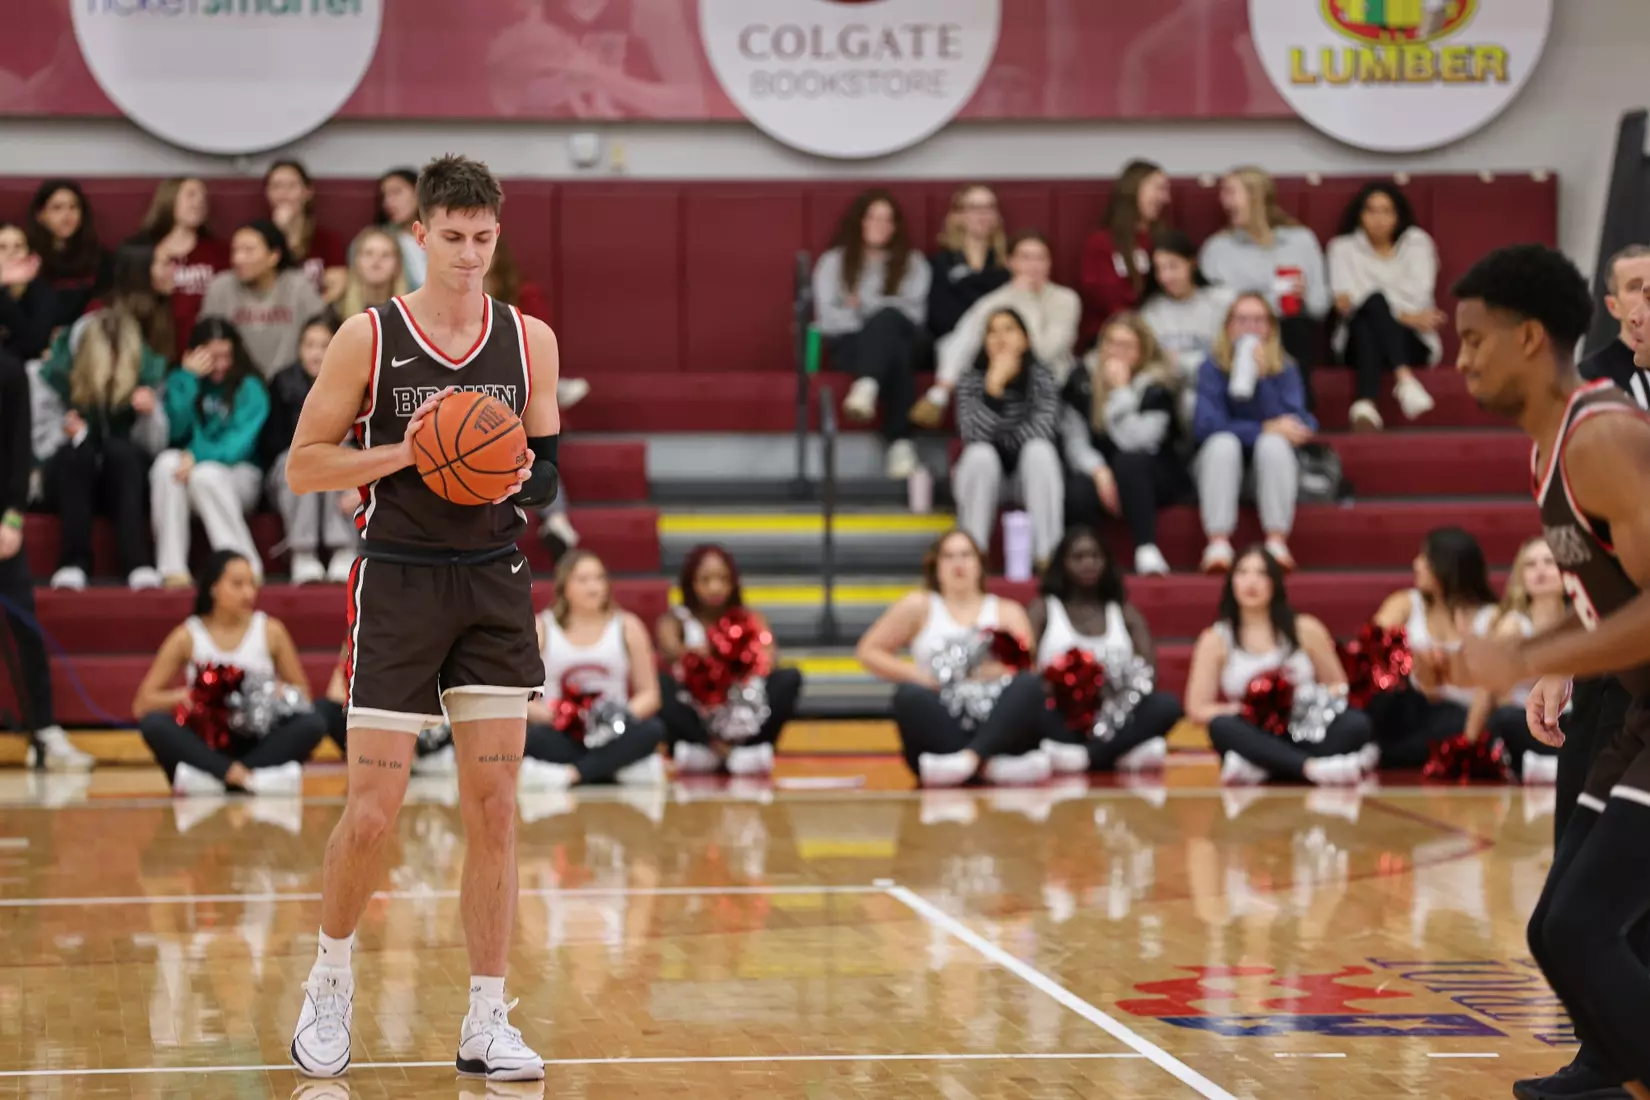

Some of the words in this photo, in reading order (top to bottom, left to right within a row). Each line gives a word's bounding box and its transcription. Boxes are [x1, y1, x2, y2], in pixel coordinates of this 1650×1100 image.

[738, 23, 963, 62] COLGATE
[1290, 45, 1509, 84] LUMBER
[749, 69, 949, 100] BOOKSTORE
[393, 384, 516, 417] BRN
